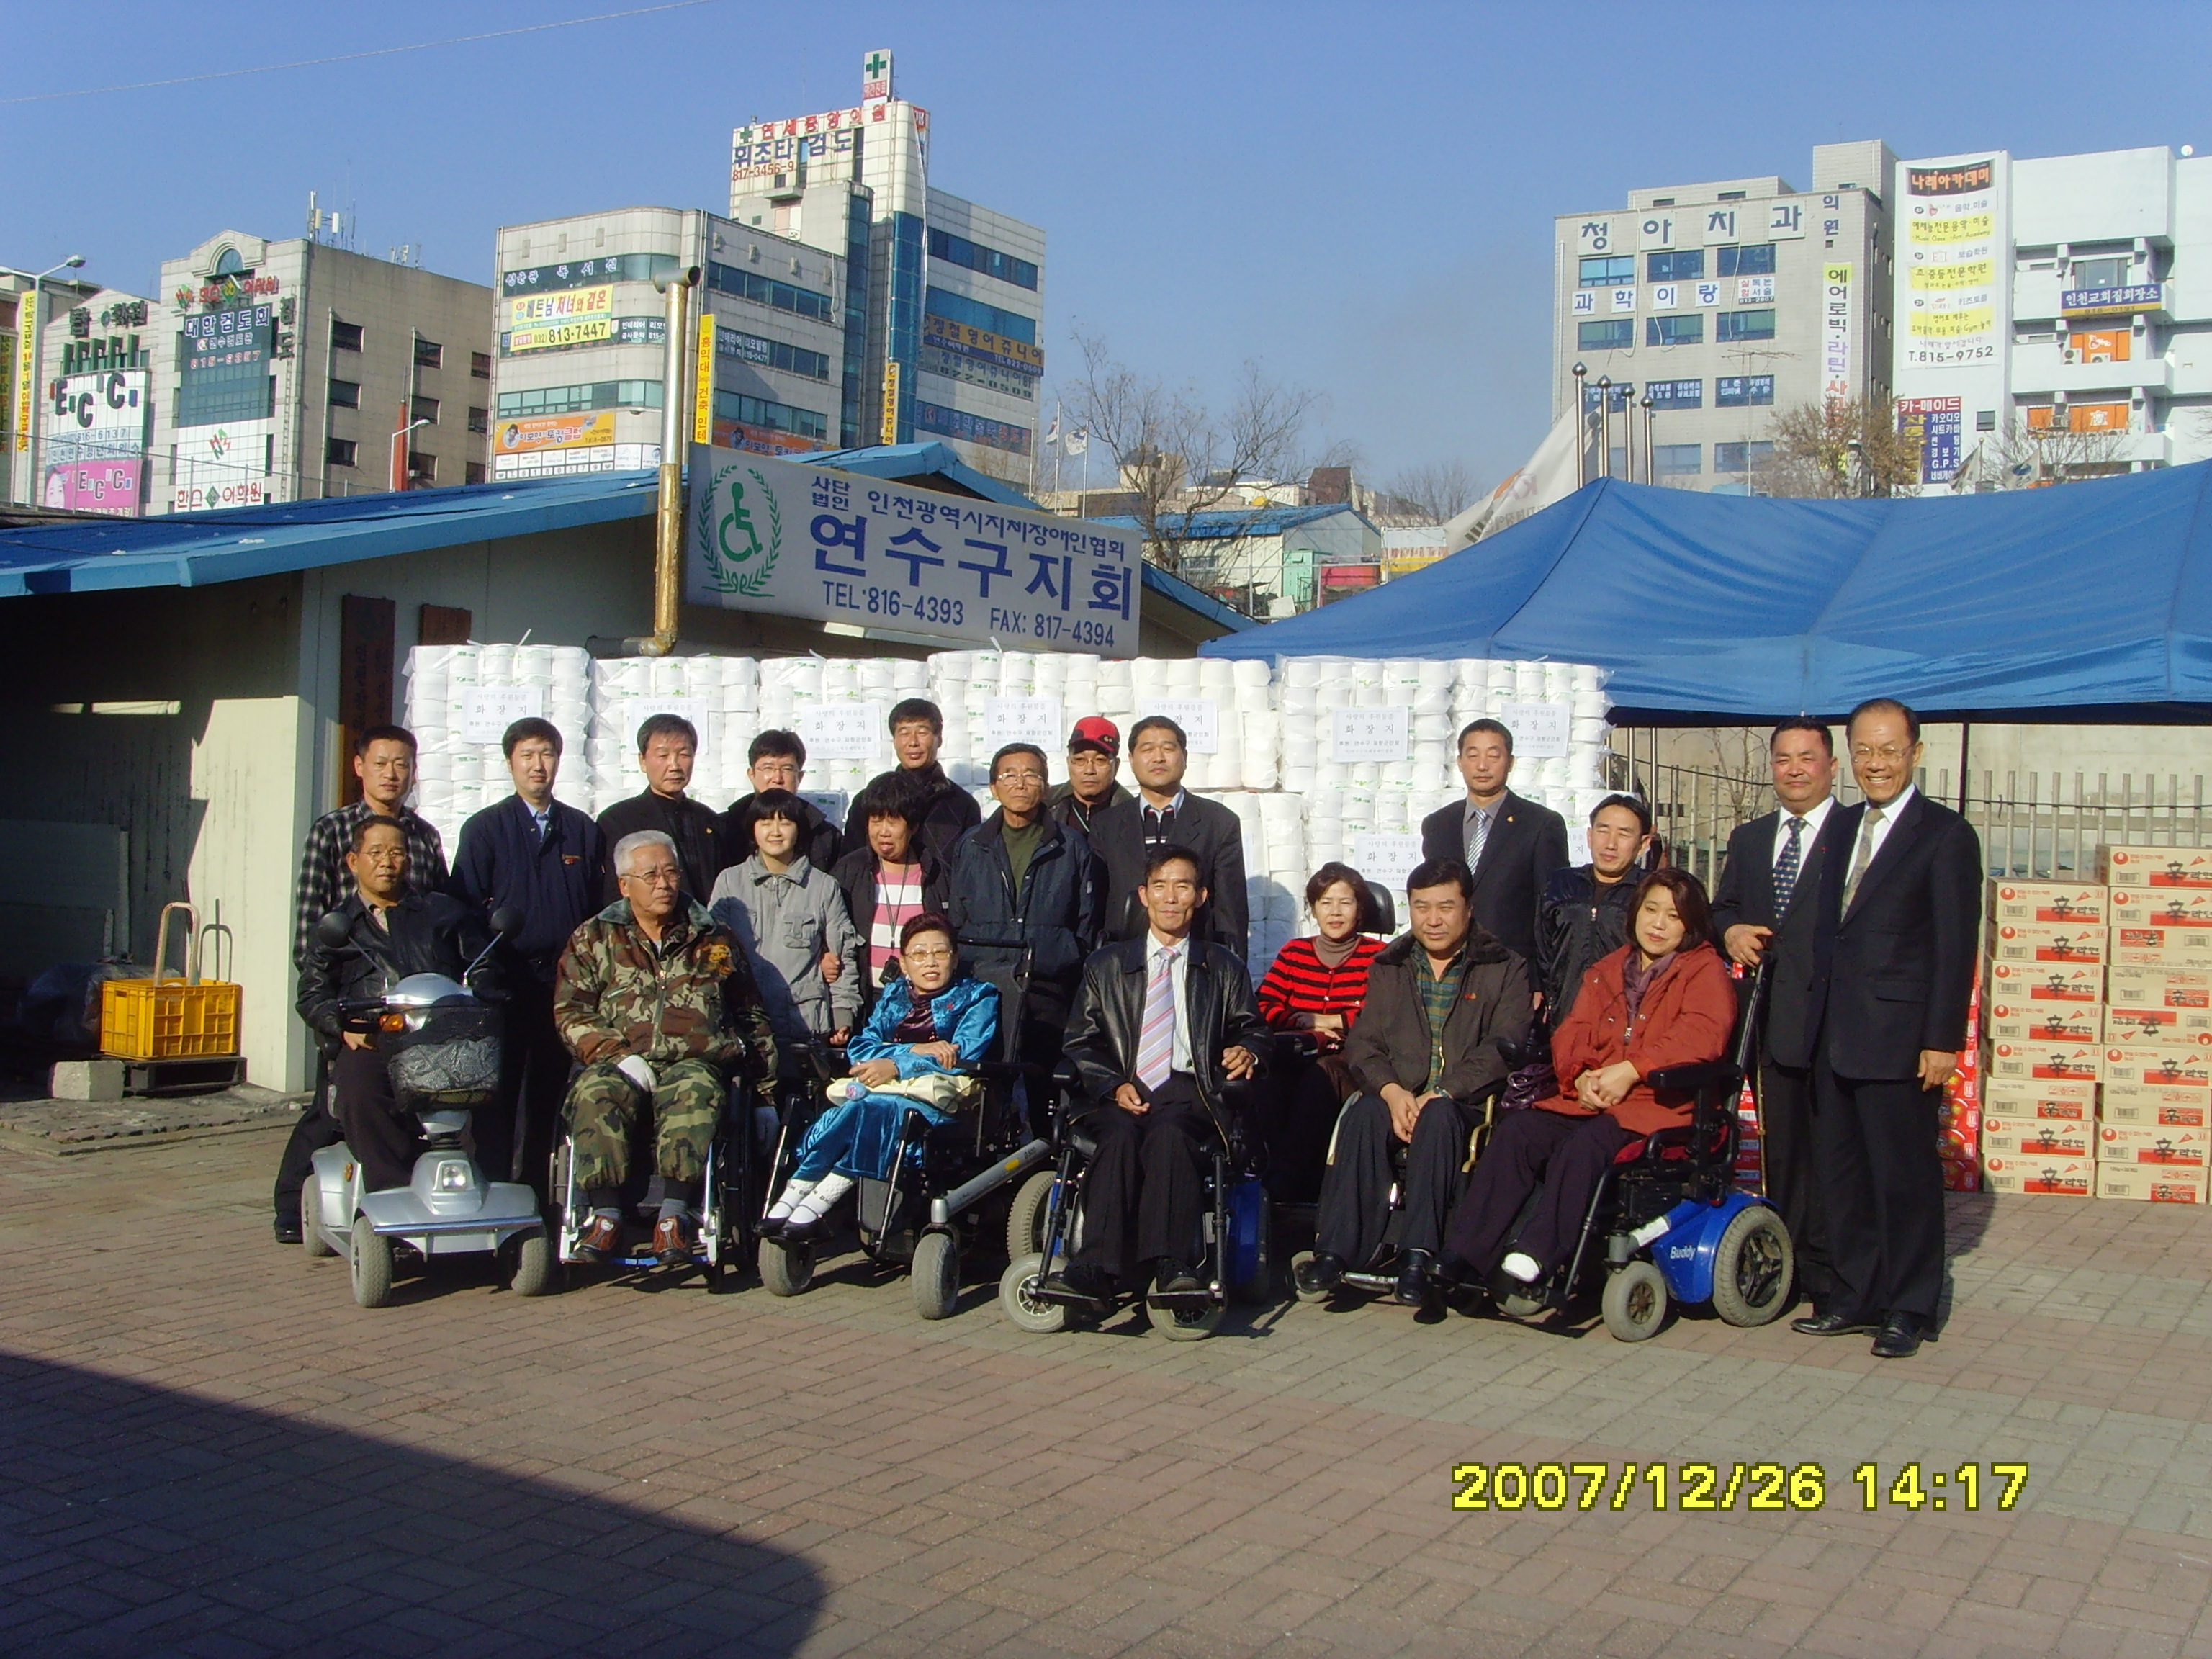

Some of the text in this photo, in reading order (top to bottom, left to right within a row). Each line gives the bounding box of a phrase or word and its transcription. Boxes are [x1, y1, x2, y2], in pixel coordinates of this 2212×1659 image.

[761, 103, 886, 141] 연세중앙의원
[808, 129, 853, 157] 검도
[732, 161, 794, 182] 817-3456-9
[1581, 204, 1802, 251] 청아치과
[587, 289, 607, 311] 결혼
[1574, 284, 1719, 313] 과학이랑
[2066, 288, 2159, 307] 인천교회집회장소
[184, 305, 271, 339] 대한검도회
[549, 321, 606, 343] 813-7447
[1908, 345, 1994, 363] T.815-9752
[1900, 397, 1960, 413] 카-메이드
[1930, 412, 1960, 424] 카오디오
[811, 475, 851, 494] 사단
[811, 491, 849, 512] 법인
[868, 490, 1125, 562] 인천광역시지체장애인협회
[810, 513, 1133, 621] 연수구지회
[867, 586, 963, 626] 816-4393
[1034, 614, 1115, 648] 817-4394
[1669, 1245, 1697, 1262] Buddy
